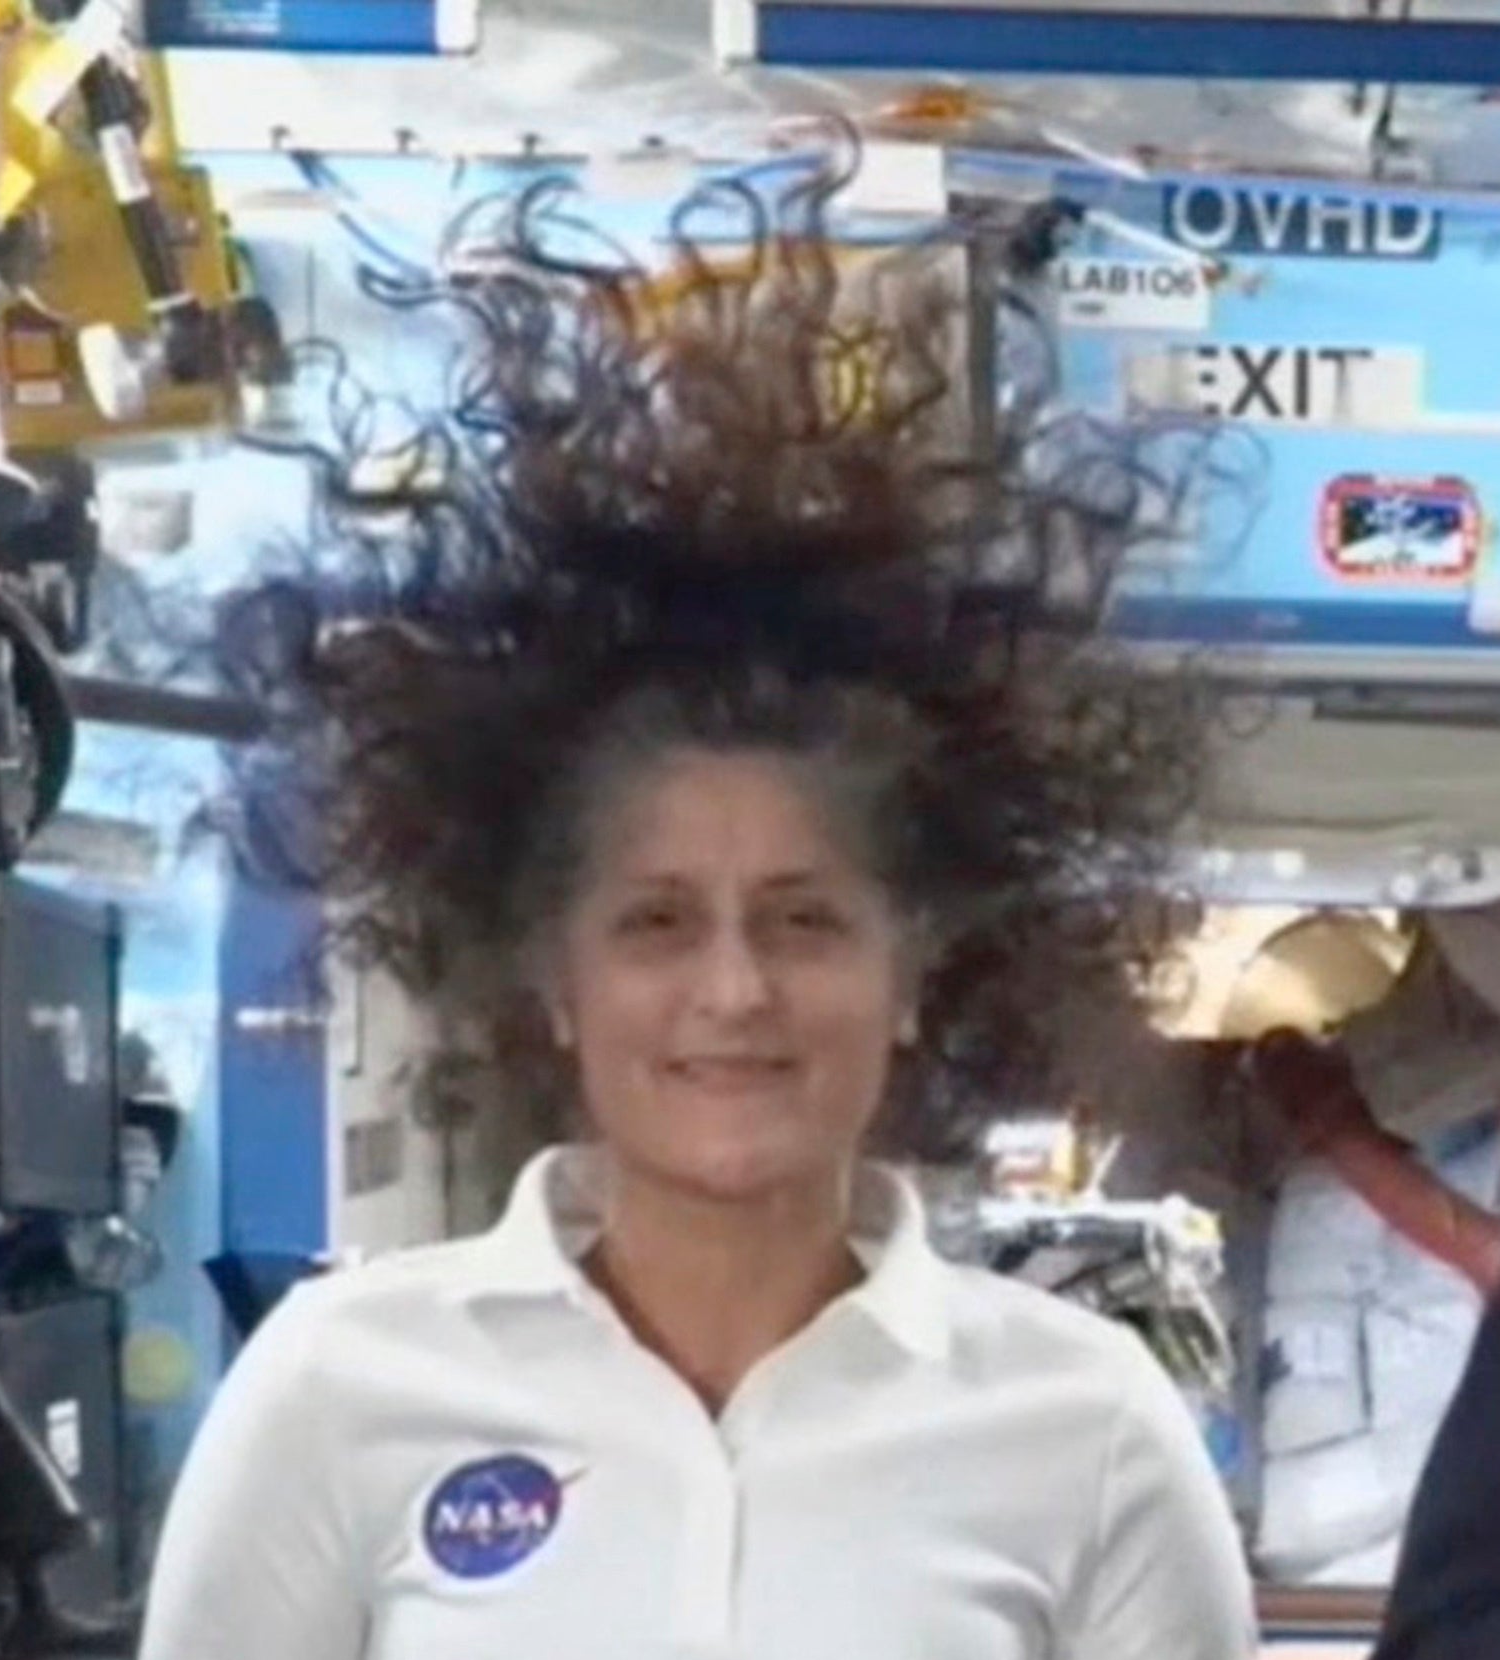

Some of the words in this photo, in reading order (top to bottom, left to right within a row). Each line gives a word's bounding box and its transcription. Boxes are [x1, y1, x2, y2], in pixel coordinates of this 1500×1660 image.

[1171, 183, 1436, 256] OVHD
[1172, 344, 1373, 417] EXIT
[434, 1501, 548, 1535] NASA
